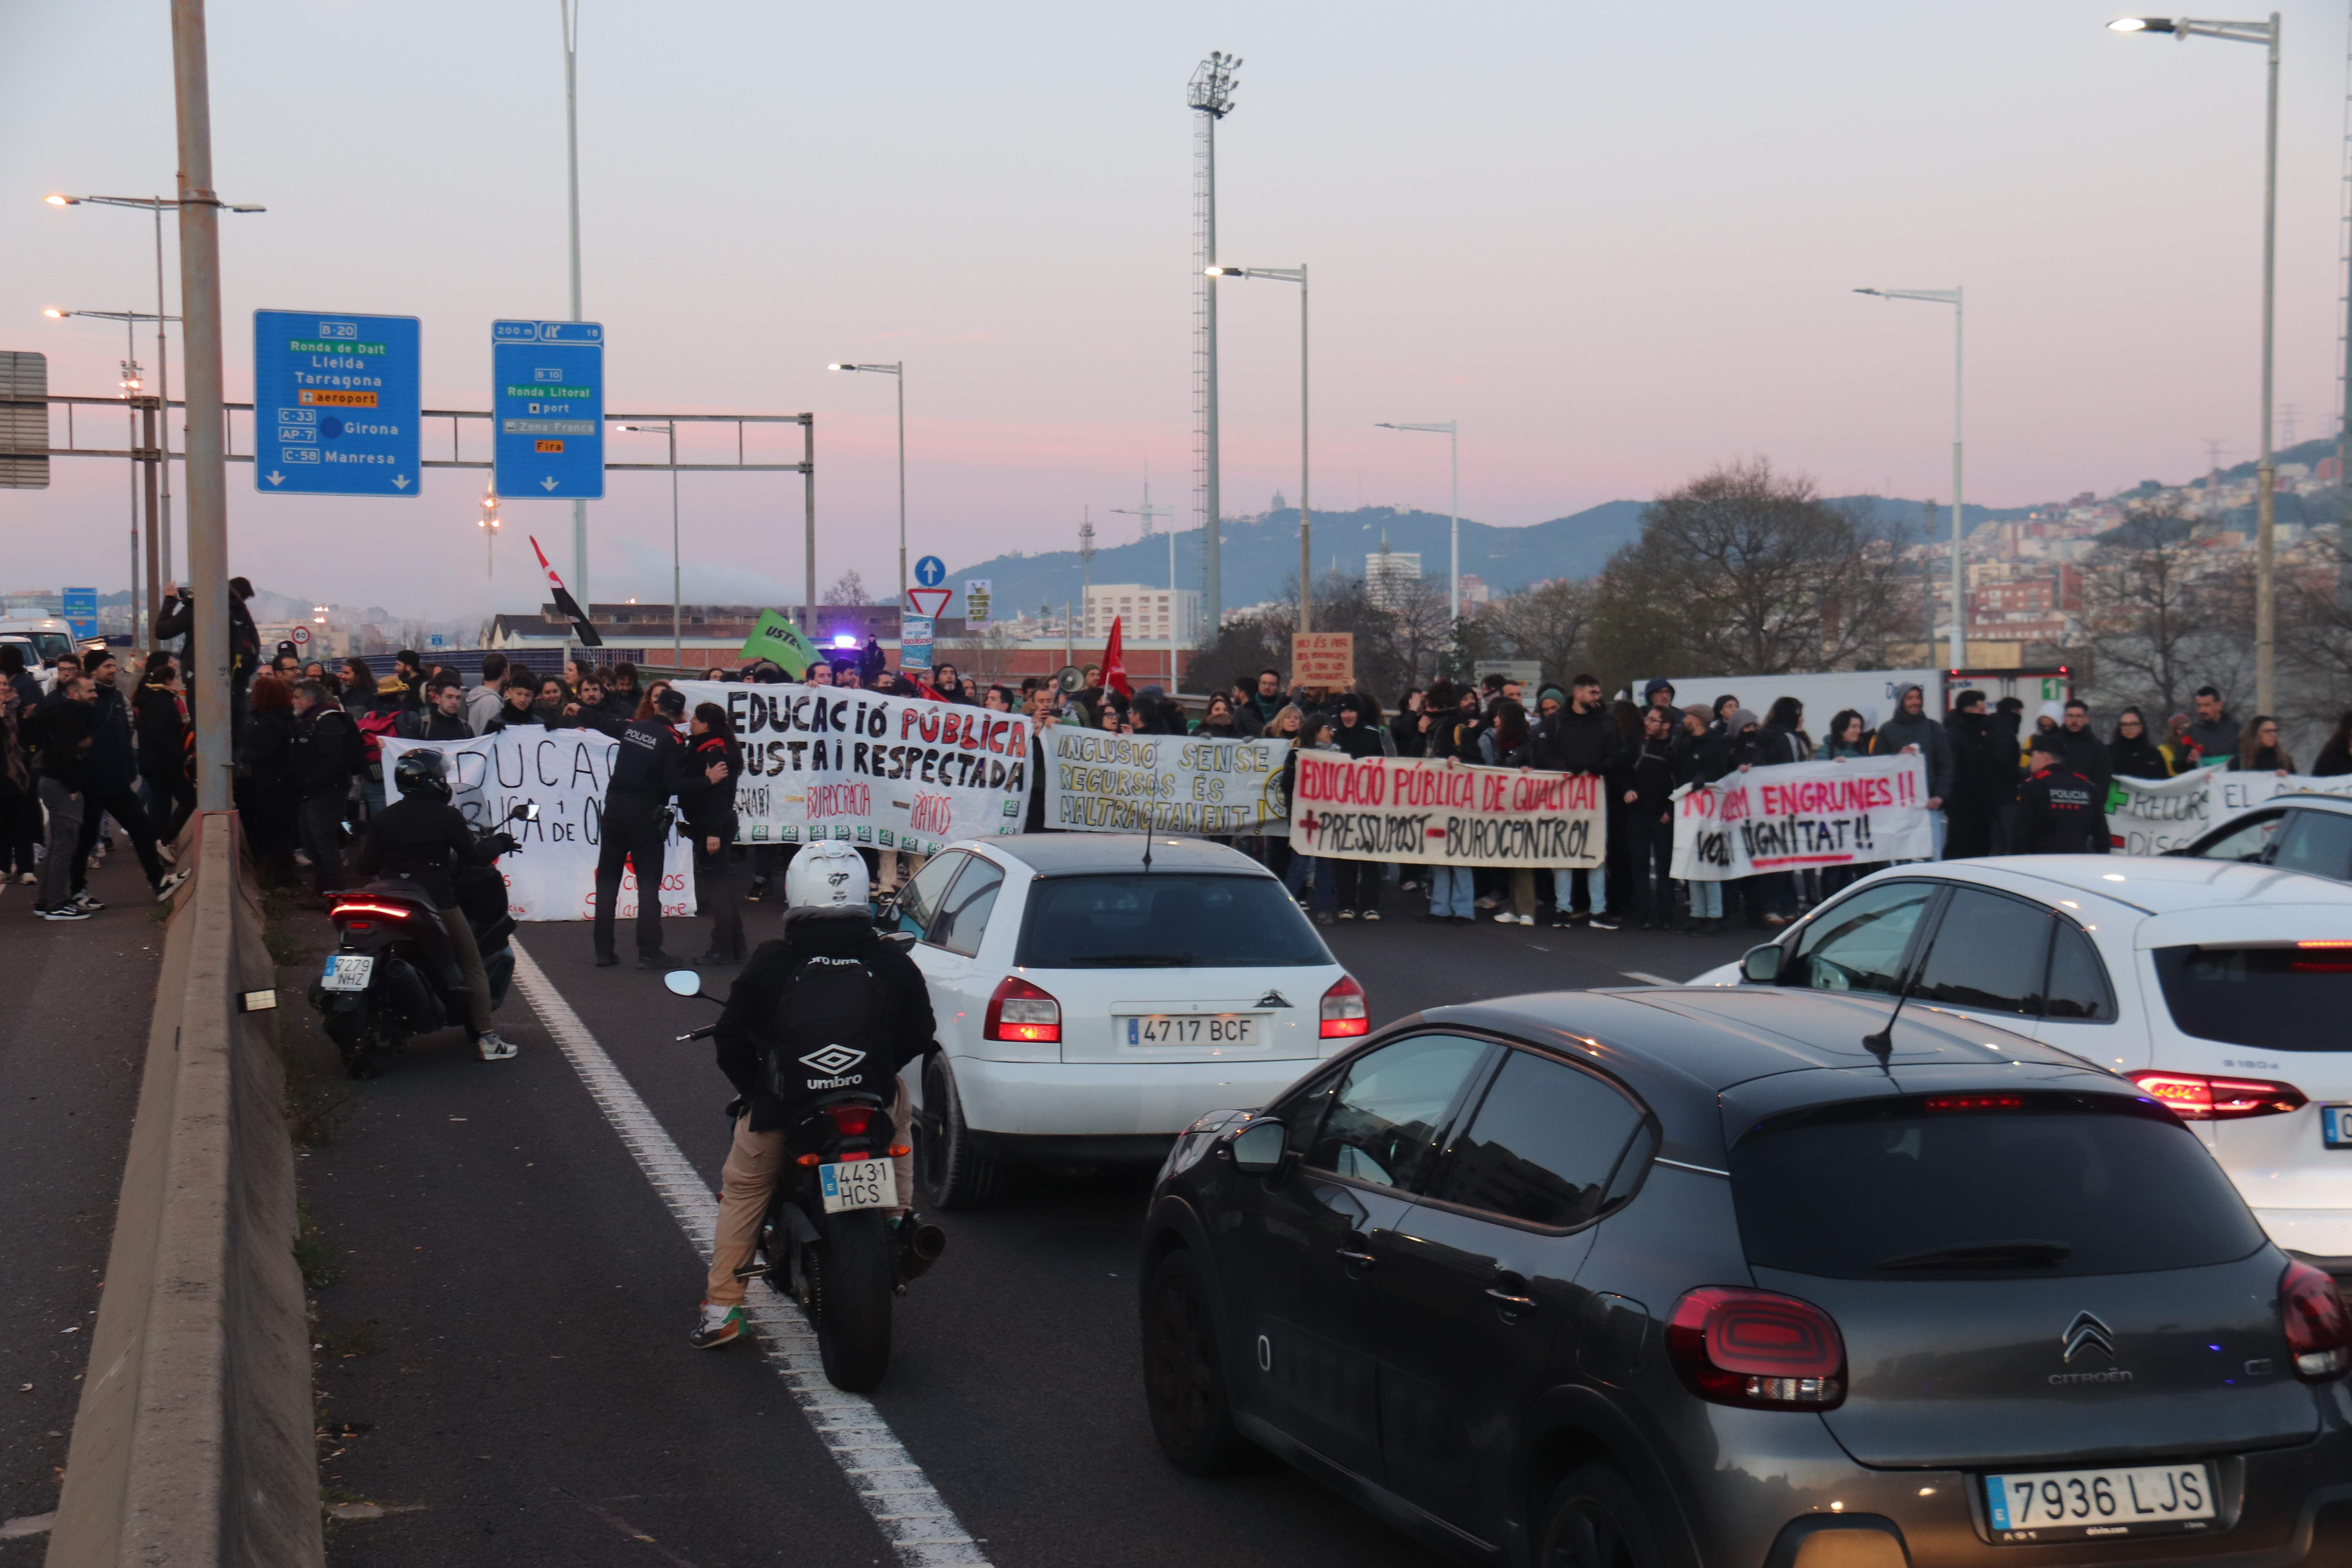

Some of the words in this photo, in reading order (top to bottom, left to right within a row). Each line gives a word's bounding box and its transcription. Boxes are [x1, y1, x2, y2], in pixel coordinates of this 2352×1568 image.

[291, 341, 331, 352] Ronda
[338, 343, 352, 353] de
[312, 356, 364, 369] Lleida
[295, 372, 382, 389] Tarragona
[508, 387, 544, 396] Ronda
[551, 388, 590, 397] Litoral
[318, 394, 376, 405] aeroport
[543, 404, 570, 414] port
[281, 412, 314, 422] C-33
[345, 422, 398, 436] Girona
[520, 422, 548, 432] Zona
[555, 423, 594, 433] Franca
[282, 430, 314, 440] AP-7
[537, 442, 562, 451] Fira
[285, 451, 318, 461] C-58
[325, 451, 395, 465] Manresa
[624, 728, 657, 746] POLICIA
[1177, 742, 1269, 775] SENSE
[854, 742, 1024, 793] RESPECTADA
[1060, 764, 1176, 800] RECURSOS
[1192, 773, 1224, 804] ÉS
[1481, 775, 1506, 811] DE
[2049, 789, 2089, 800] POLICIA
[2225, 784, 2251, 808] EL
[553, 822, 575, 842] DE
[1446, 816, 1596, 860] BUROCONTROL
[336, 959, 370, 972] 7279
[338, 973, 363, 985] NHZ
[1144, 1020, 1200, 1041] 4717
[1210, 1020, 1251, 1041] BCF
[807, 1074, 862, 1089] umbro
[840, 1162, 886, 1183] 4431
[841, 1184, 879, 1206] HCS
[2014, 1477, 2116, 1522] 7936
[2127, 1472, 2202, 1514] LJS
[1995, 1510, 2005, 1521] E
